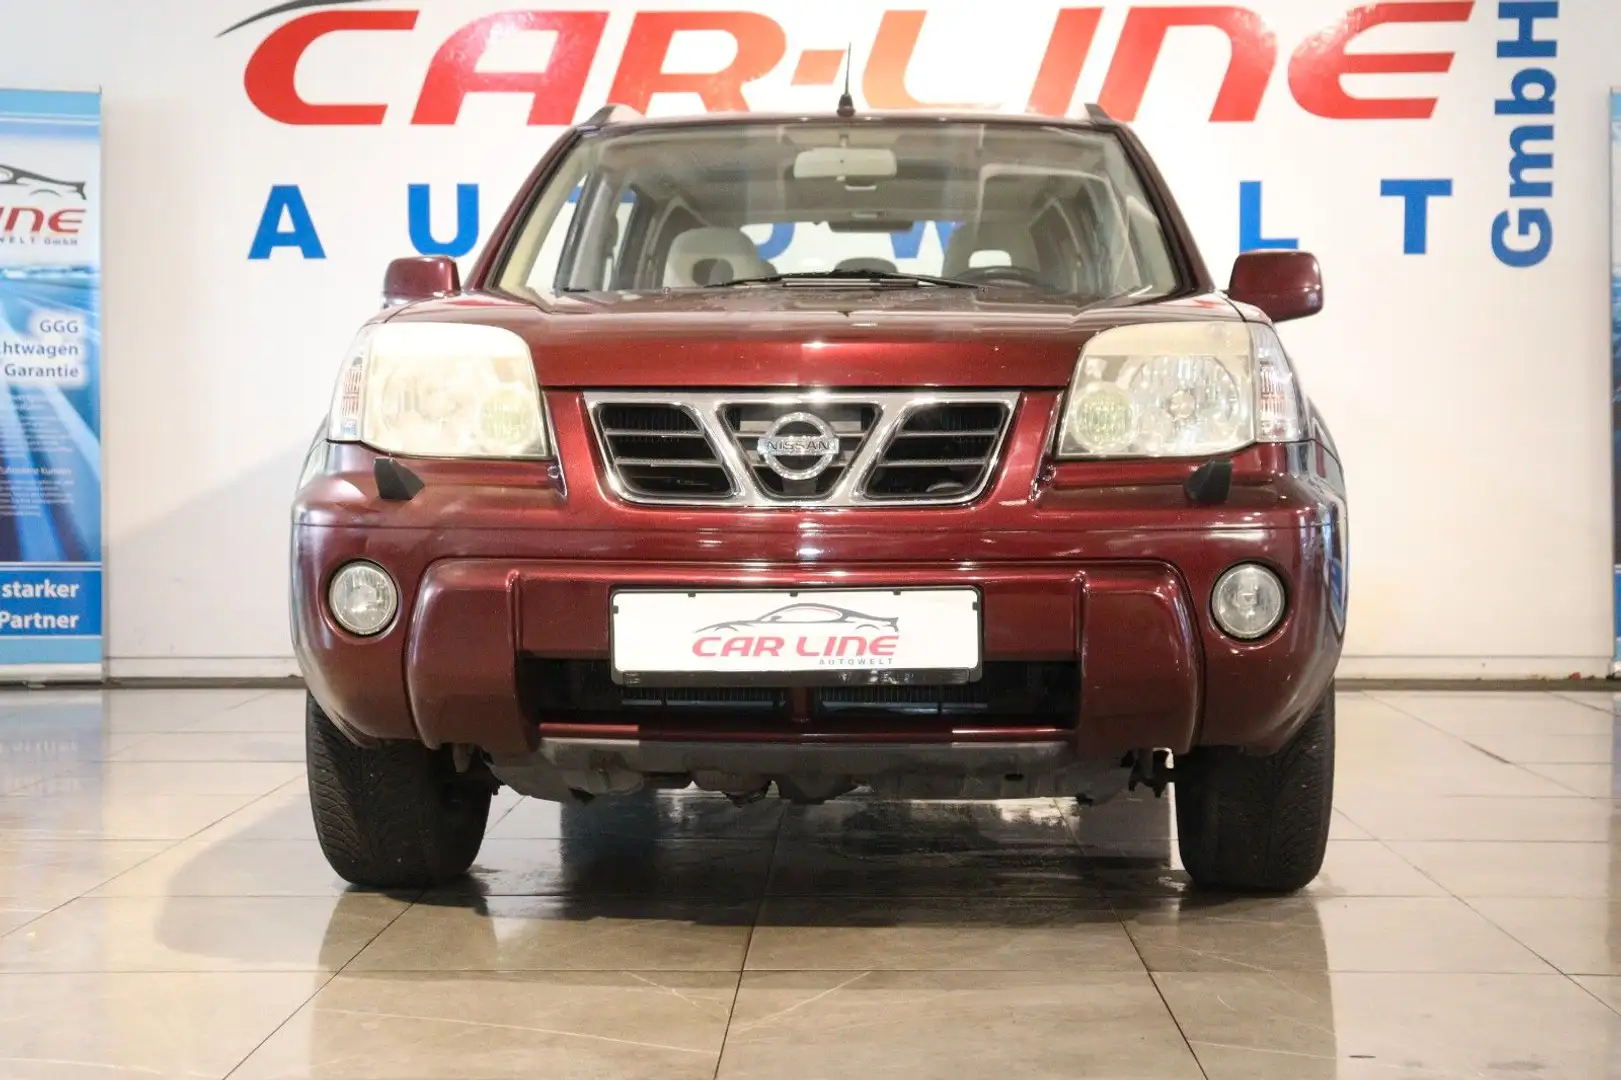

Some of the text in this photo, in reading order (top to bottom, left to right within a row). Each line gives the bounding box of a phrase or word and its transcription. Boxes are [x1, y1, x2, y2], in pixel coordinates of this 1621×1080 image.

[1490, 1, 1559, 268] GmbH
[248, 179, 1452, 260] AULT
[39, 319, 79, 334] GGG
[3, 341, 79, 359] htwagen
[4, 362, 79, 378] Garantie
[766, 440, 830, 451] NISSAN
[2, 578, 80, 598] starker
[0, 610, 80, 629] Partner
[692, 635, 900, 657] CAR LINE
[818, 657, 894, 666] AUTOWELT
